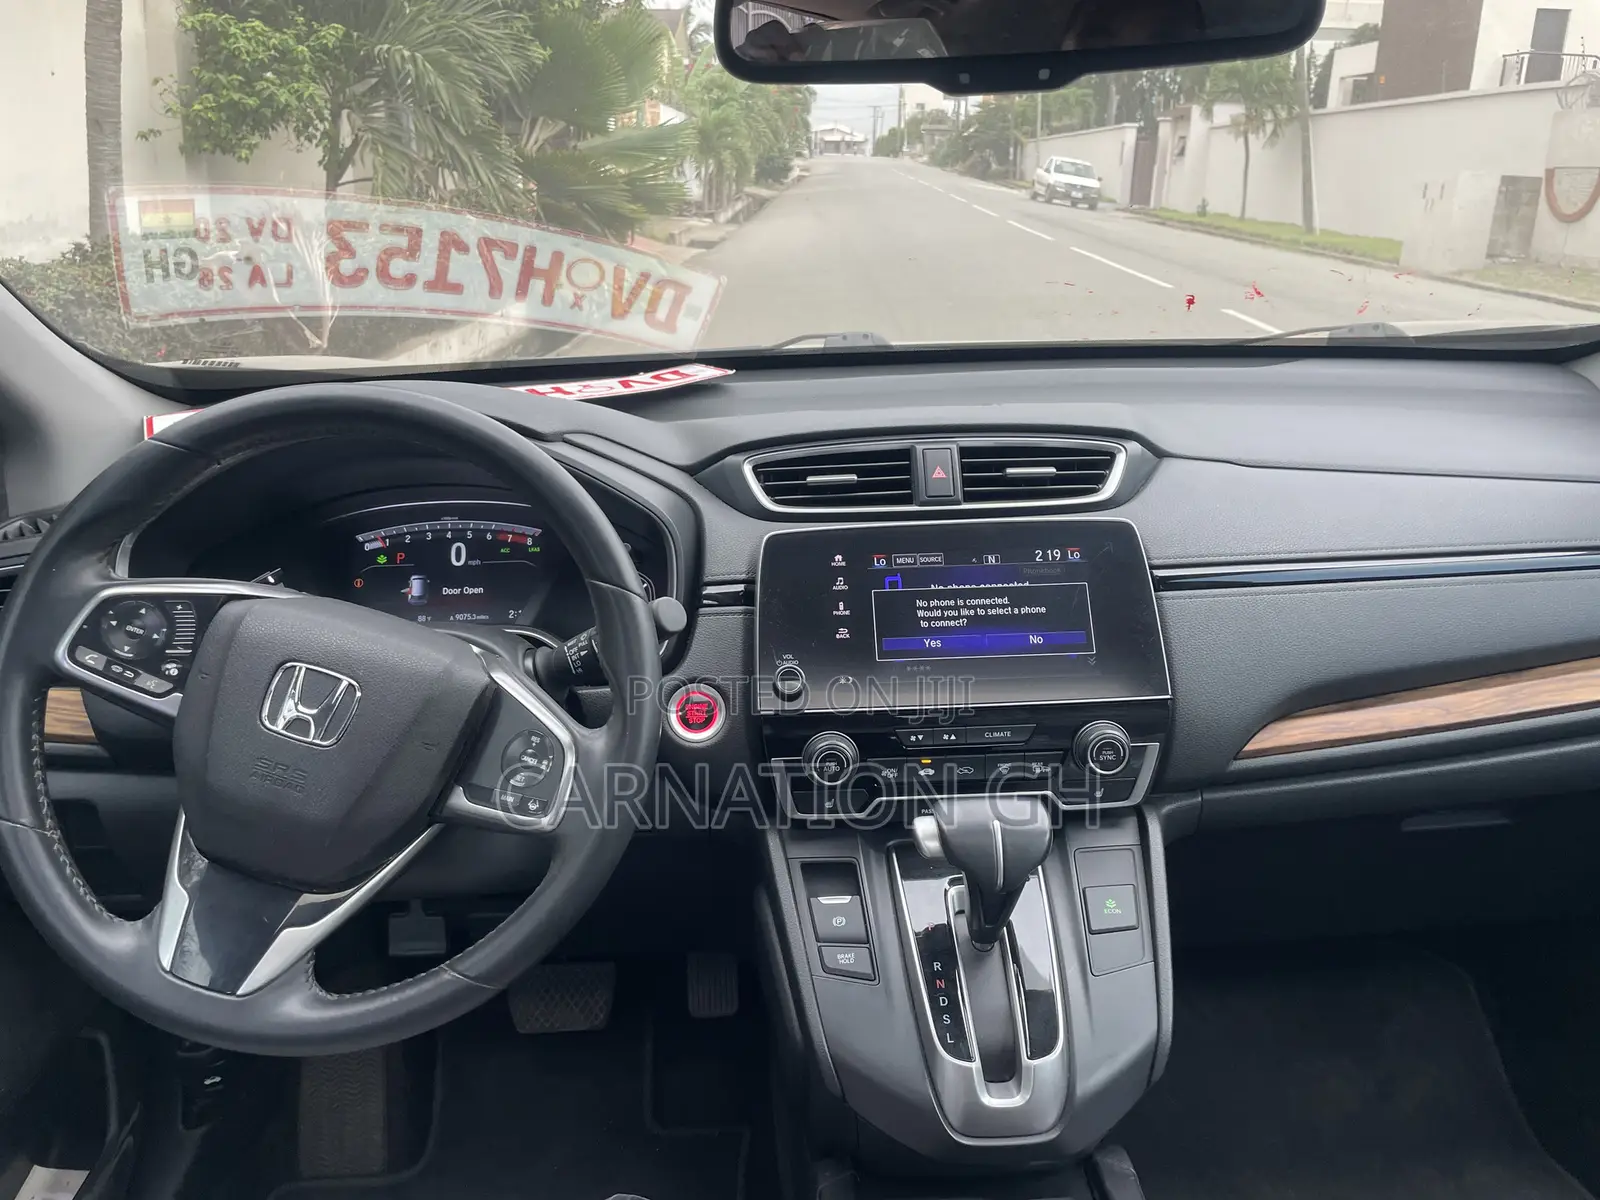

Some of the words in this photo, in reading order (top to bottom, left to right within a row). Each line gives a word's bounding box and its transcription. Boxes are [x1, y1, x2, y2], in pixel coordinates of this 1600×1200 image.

[404, 534, 411, 543] 2
[426, 532, 432, 540] 3
[446, 531, 452, 539] 4
[467, 531, 473, 539] 5
[486, 532, 492, 540] 6
[507, 534, 513, 542] 7
[385, 538, 390, 547] 1
[526, 537, 533, 545] 8
[364, 543, 370, 551] 0
[396, 553, 406, 563] P
[450, 542, 467, 566] 0
[1068, 550, 1081, 560] Lo
[873, 557, 886, 566] Lo
[442, 587, 461, 595] Door
[463, 586, 484, 595] Open
[916, 599, 929, 607] No
[930, 599, 955, 609] phone
[957, 598, 964, 606] is
[966, 597, 1010, 606] connected.
[917, 609, 942, 617] Would
[943, 610, 959, 619] you
[960, 608, 975, 616] like
[977, 608, 986, 616] to
[987, 607, 1012, 615] select
[1020, 606, 1046, 616] phone
[920, 619, 929, 628] to
[930, 618, 968, 627] connect?
[923, 638, 942, 648] Yes
[1029, 635, 1044, 644] No
[837, 952, 856, 960] BRAKE
[933, 961, 942, 971] R
[936, 979, 945, 989] N
[939, 996, 949, 1007] D
[942, 1014, 951, 1025] S
[946, 1032, 955, 1044] L
